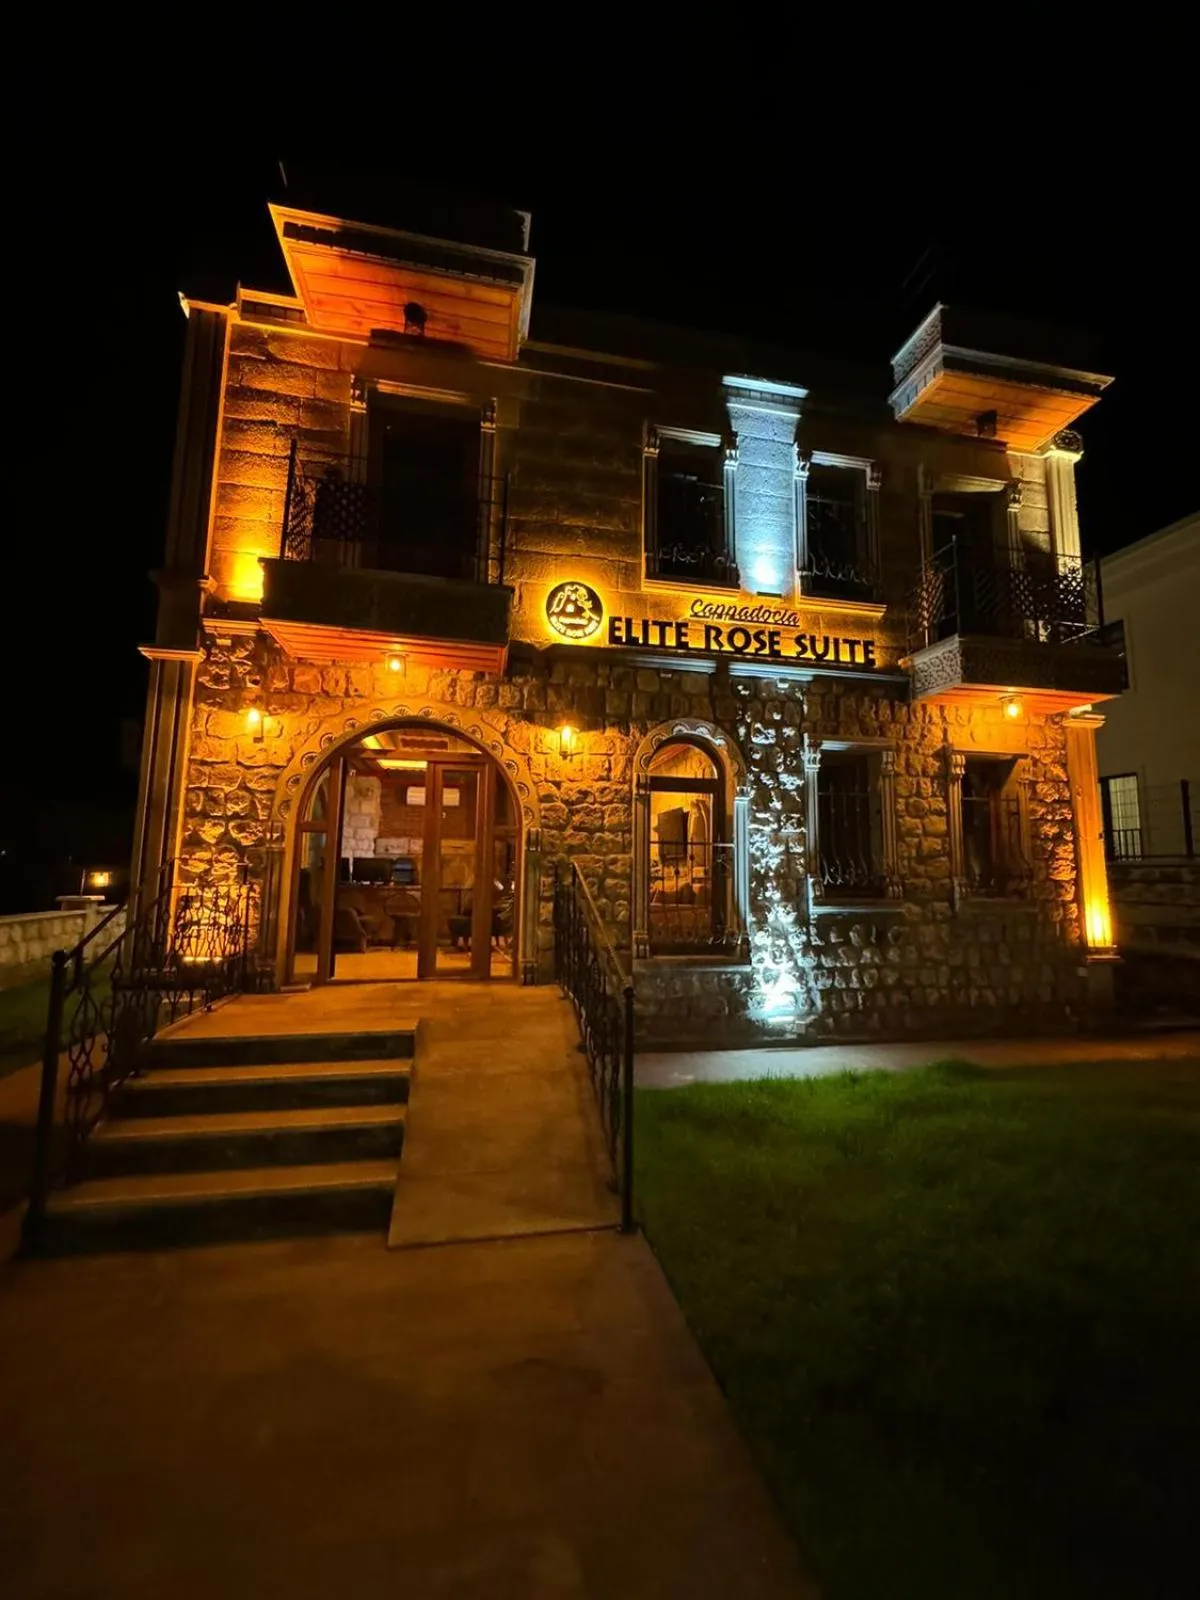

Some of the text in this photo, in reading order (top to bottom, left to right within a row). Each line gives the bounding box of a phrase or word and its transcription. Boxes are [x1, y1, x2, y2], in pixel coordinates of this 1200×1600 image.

[608, 616, 689, 649] ELITE
[704, 624, 781, 657] ROSE
[794, 633, 876, 666] SUITE
